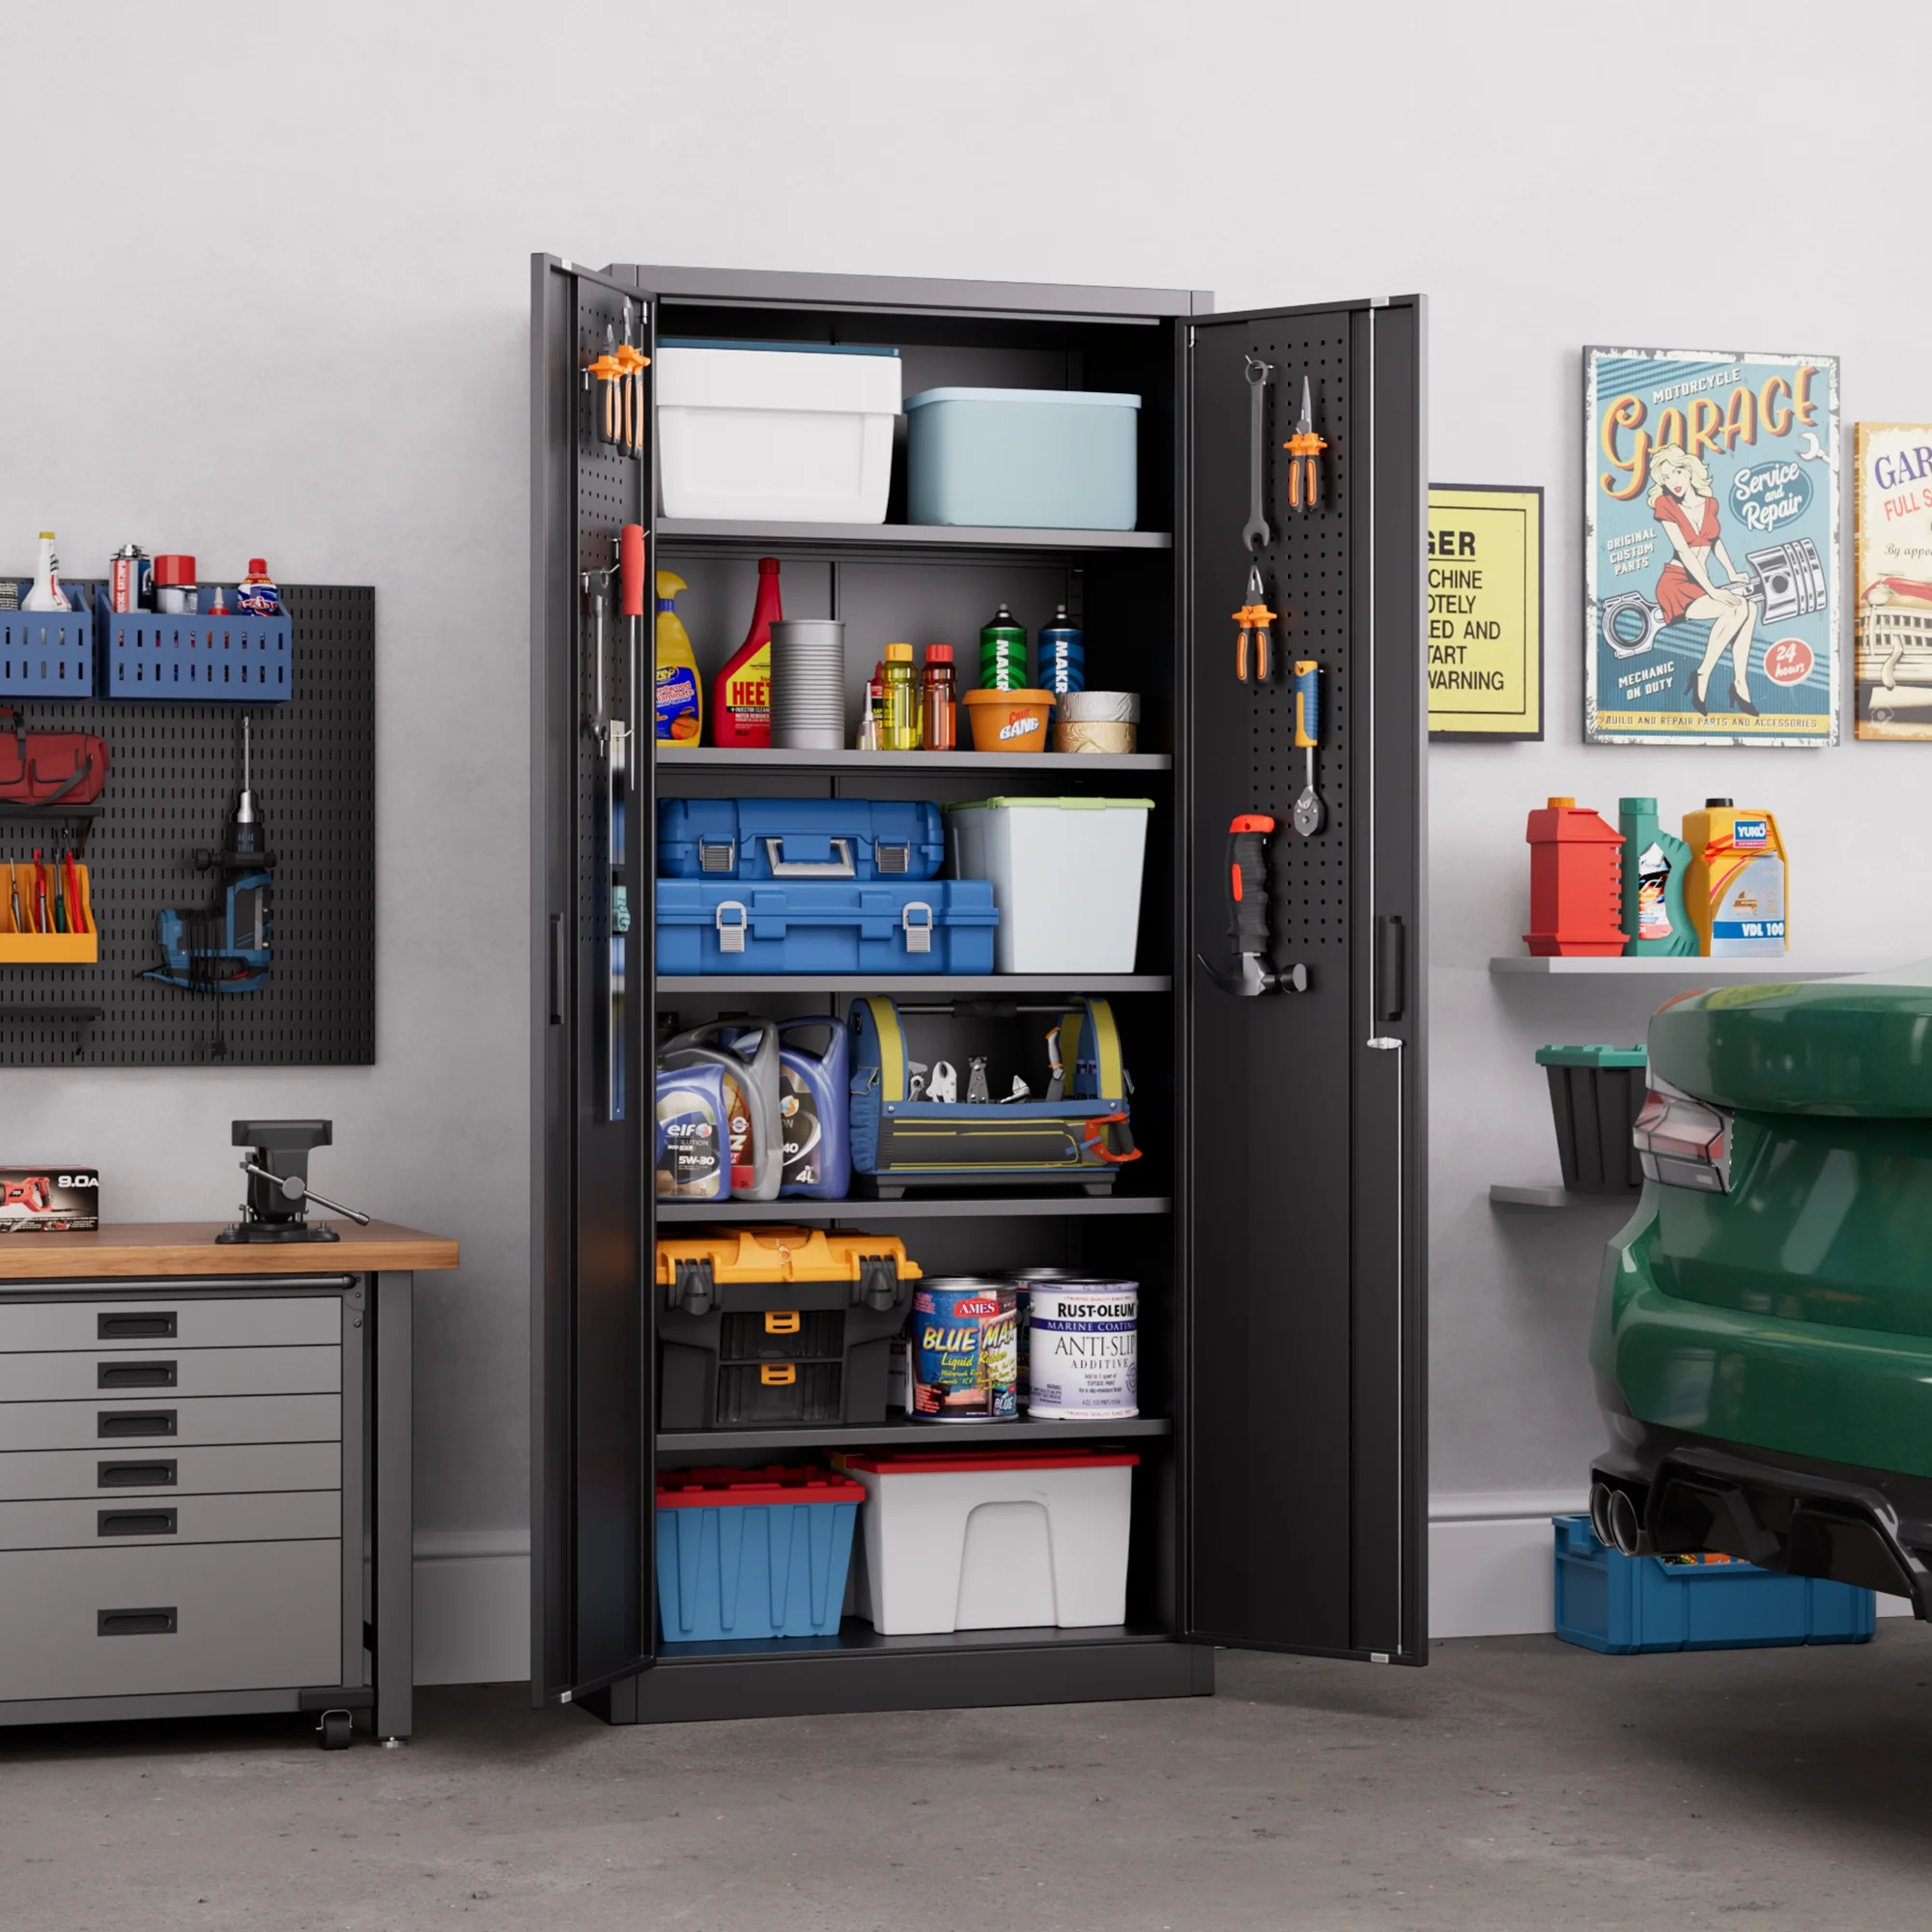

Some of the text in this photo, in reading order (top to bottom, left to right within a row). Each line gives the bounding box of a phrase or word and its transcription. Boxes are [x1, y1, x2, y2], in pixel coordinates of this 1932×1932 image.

[1654, 369, 1742, 404] MOTORCYCLE
[1600, 365, 1820, 501] GARAGE
[1734, 462, 1800, 500] Service
[1764, 484, 1785, 502] and
[1742, 493, 1803, 532] Repair
[1884, 493, 1920, 522] FULL
[1607, 527, 1657, 552] ORIGINAL
[1610, 542, 1654, 564] CUSTOM
[1884, 543, 1900, 557] By
[1615, 556, 1649, 576] PARTS
[1428, 619, 1501, 639] ED AND
[1776, 643, 1797, 663] 24
[1618, 661, 1674, 689] MECHANIC
[1775, 662, 1805, 677] hours
[1626, 677, 1673, 700] ON DUTY
[999, 717, 1039, 740] BANG
[1605, 716, 1817, 728] BUILD AND REPAIR PARTS AND ACCESSORIES
[1742, 923, 1784, 937] VDL 100
[668, 1123, 696, 1136] elf
[678, 1155, 715, 1165] 5W-30
[58, 1175, 99, 1187] 9.0A
[795, 1169, 815, 1183] 4L
[959, 1303, 996, 1315] AMES
[1057, 1302, 1136, 1318] RUST-OLEUM
[923, 1318, 1016, 1352] BLUE MAX
[1047, 1321, 1094, 1331] MARINE
[1055, 1334, 1136, 1356] ANTI-SLIP
[941, 1351, 975, 1371] Liquid
[1070, 1357, 1128, 1369] ADDITIVE
[994, 1396, 1013, 1409] BLUE
